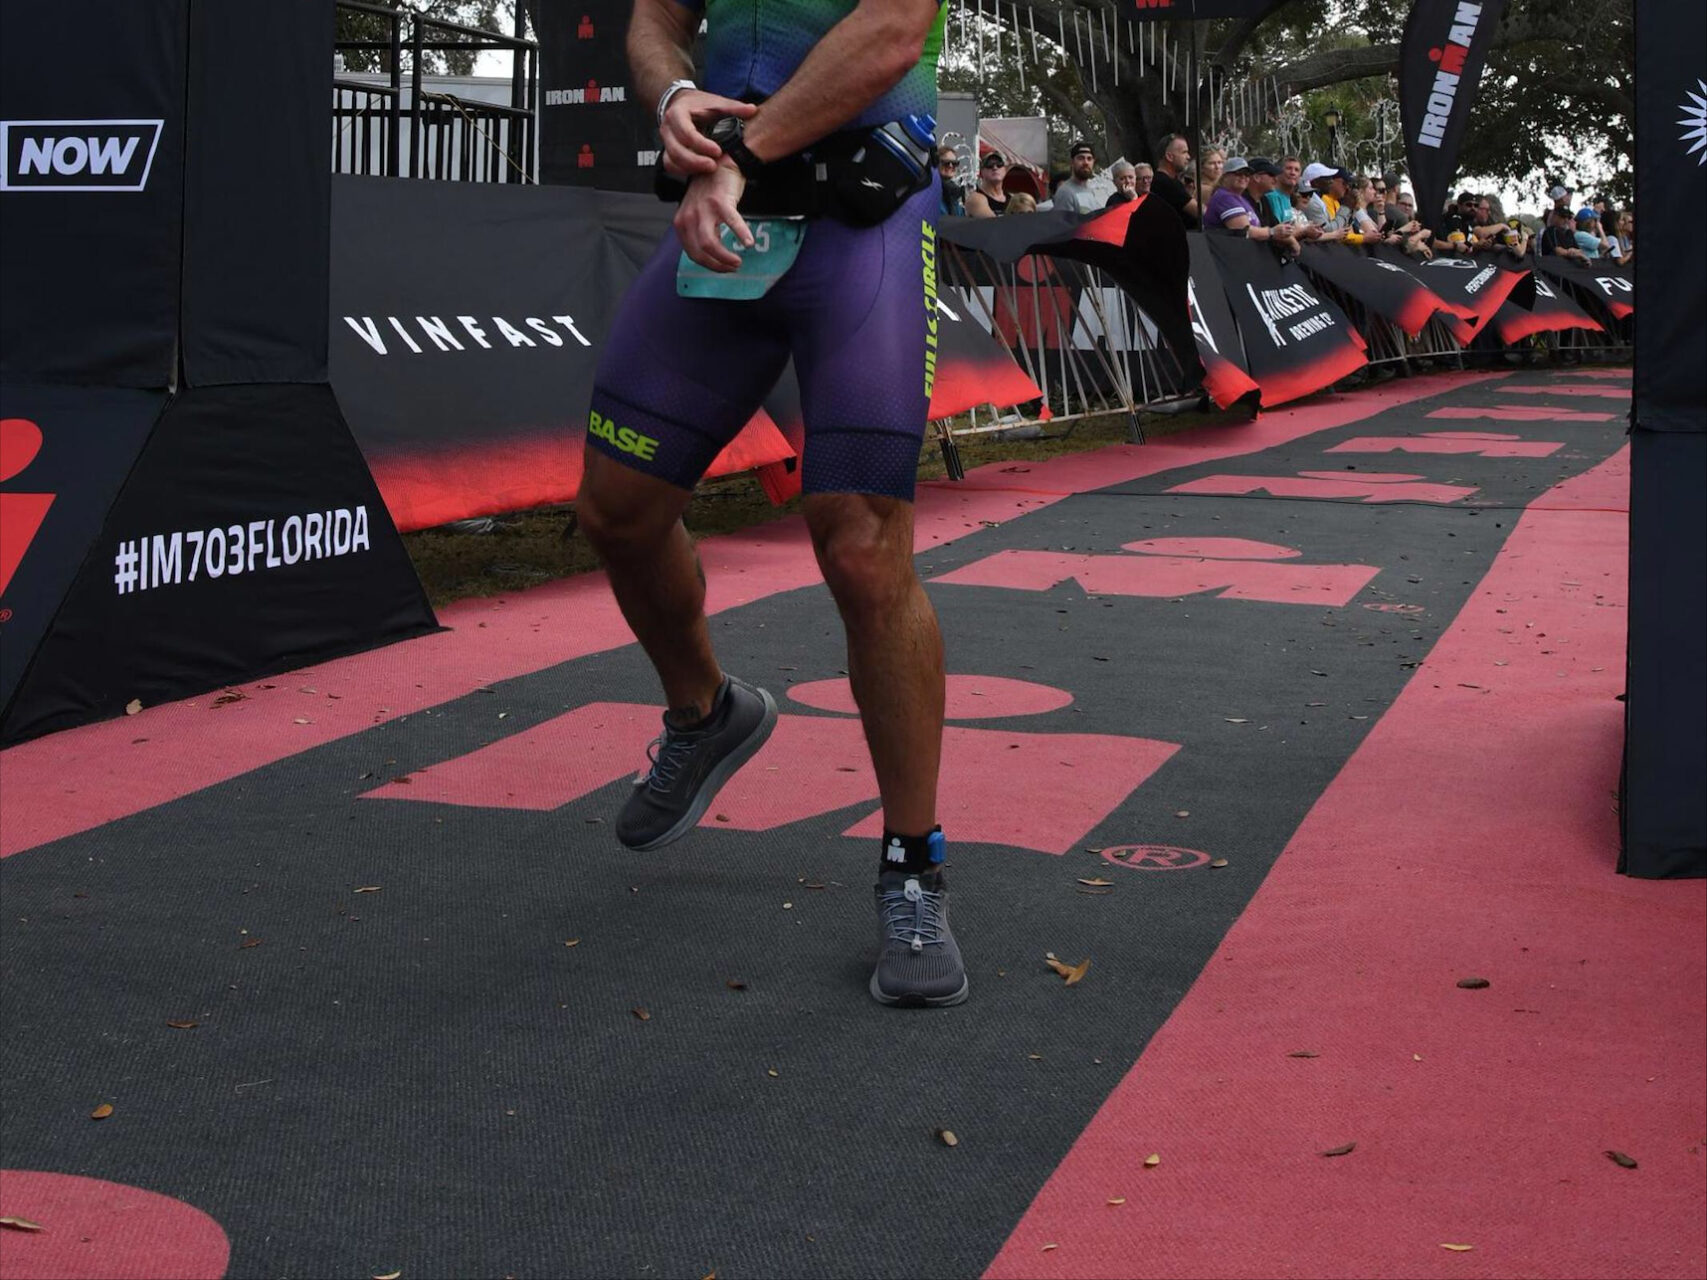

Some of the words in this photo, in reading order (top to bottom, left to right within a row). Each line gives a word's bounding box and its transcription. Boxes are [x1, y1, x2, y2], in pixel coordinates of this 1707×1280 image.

[545, 79, 626, 106] IRONMAN
[1417, 0, 1483, 149] IRONMAN
[18, 136, 140, 176] NOW
[343, 315, 592, 355] VINFAST
[589, 410, 660, 462] BASE
[114, 505, 371, 595] #IM703FLORIDA
